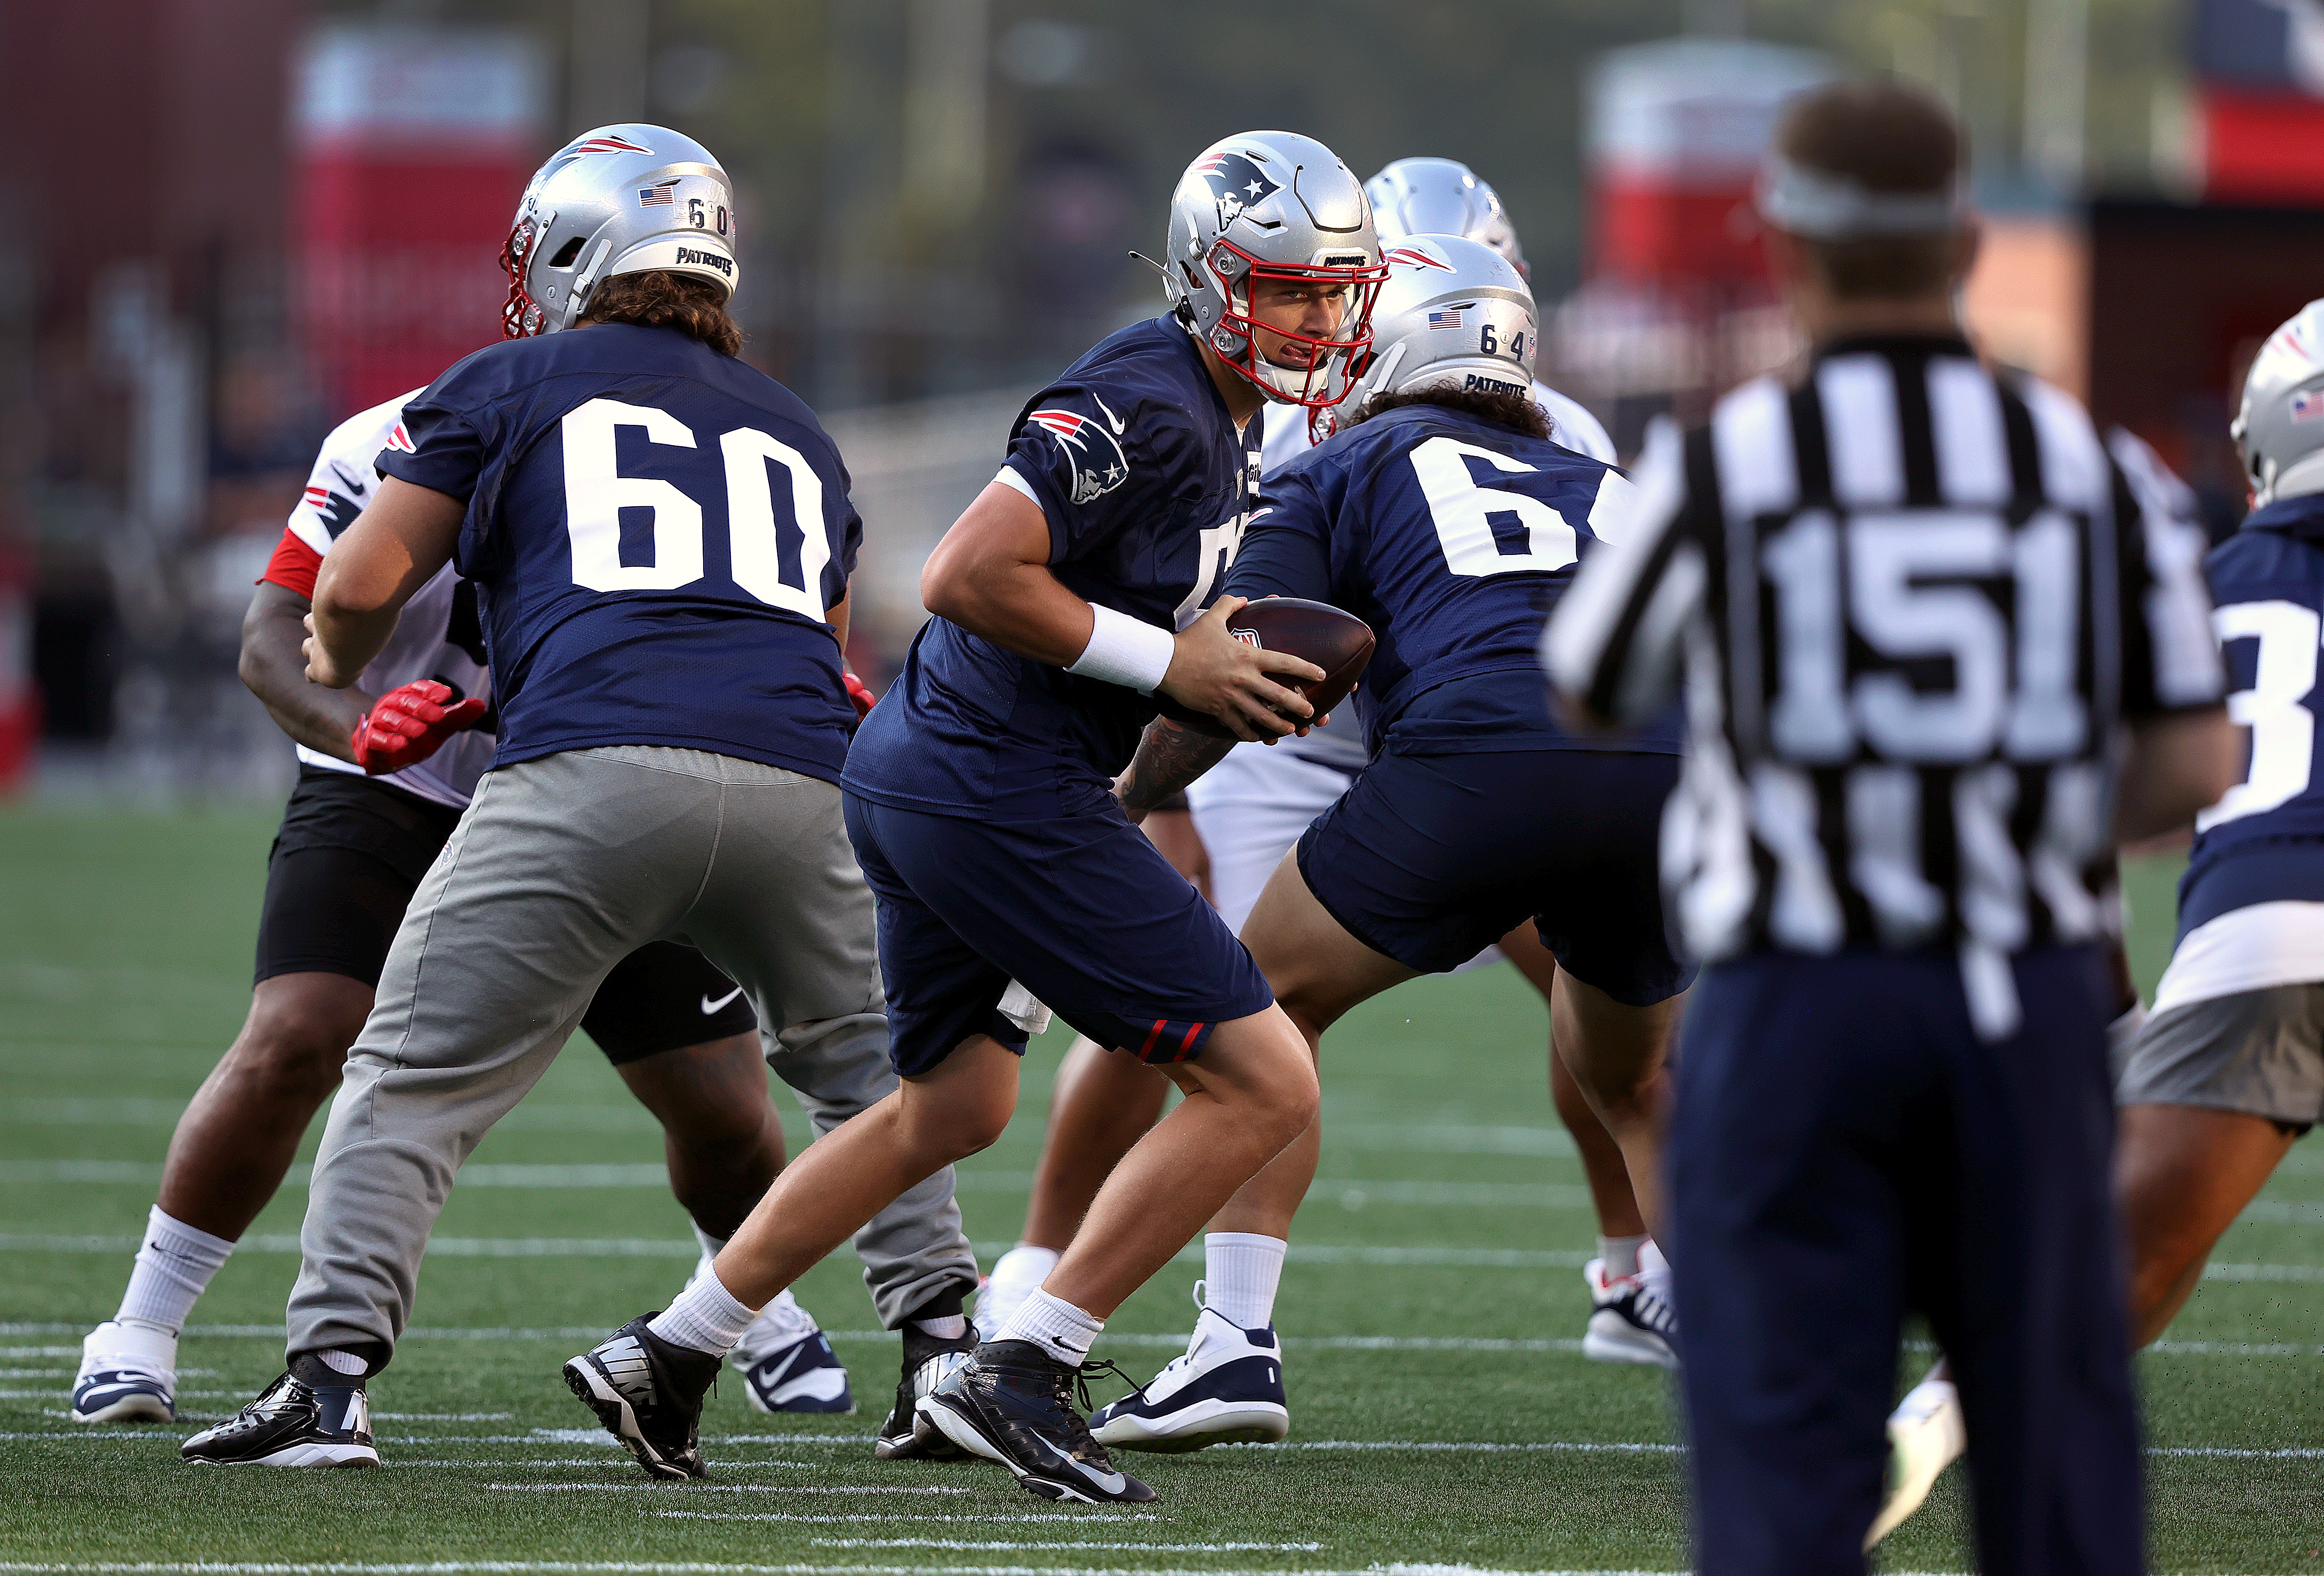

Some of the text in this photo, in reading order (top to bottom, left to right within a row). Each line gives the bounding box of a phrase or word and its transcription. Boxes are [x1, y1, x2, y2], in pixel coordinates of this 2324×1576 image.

[689, 198, 728, 236] 60
[676, 247, 732, 277] PATRIOTS
[1324, 255, 1366, 267] PATRIOTS
[1481, 324, 1524, 362] 64
[1464, 374, 1526, 399] PATRIOTS
[562, 398, 831, 624] 60
[1761, 507, 2089, 764] 151
